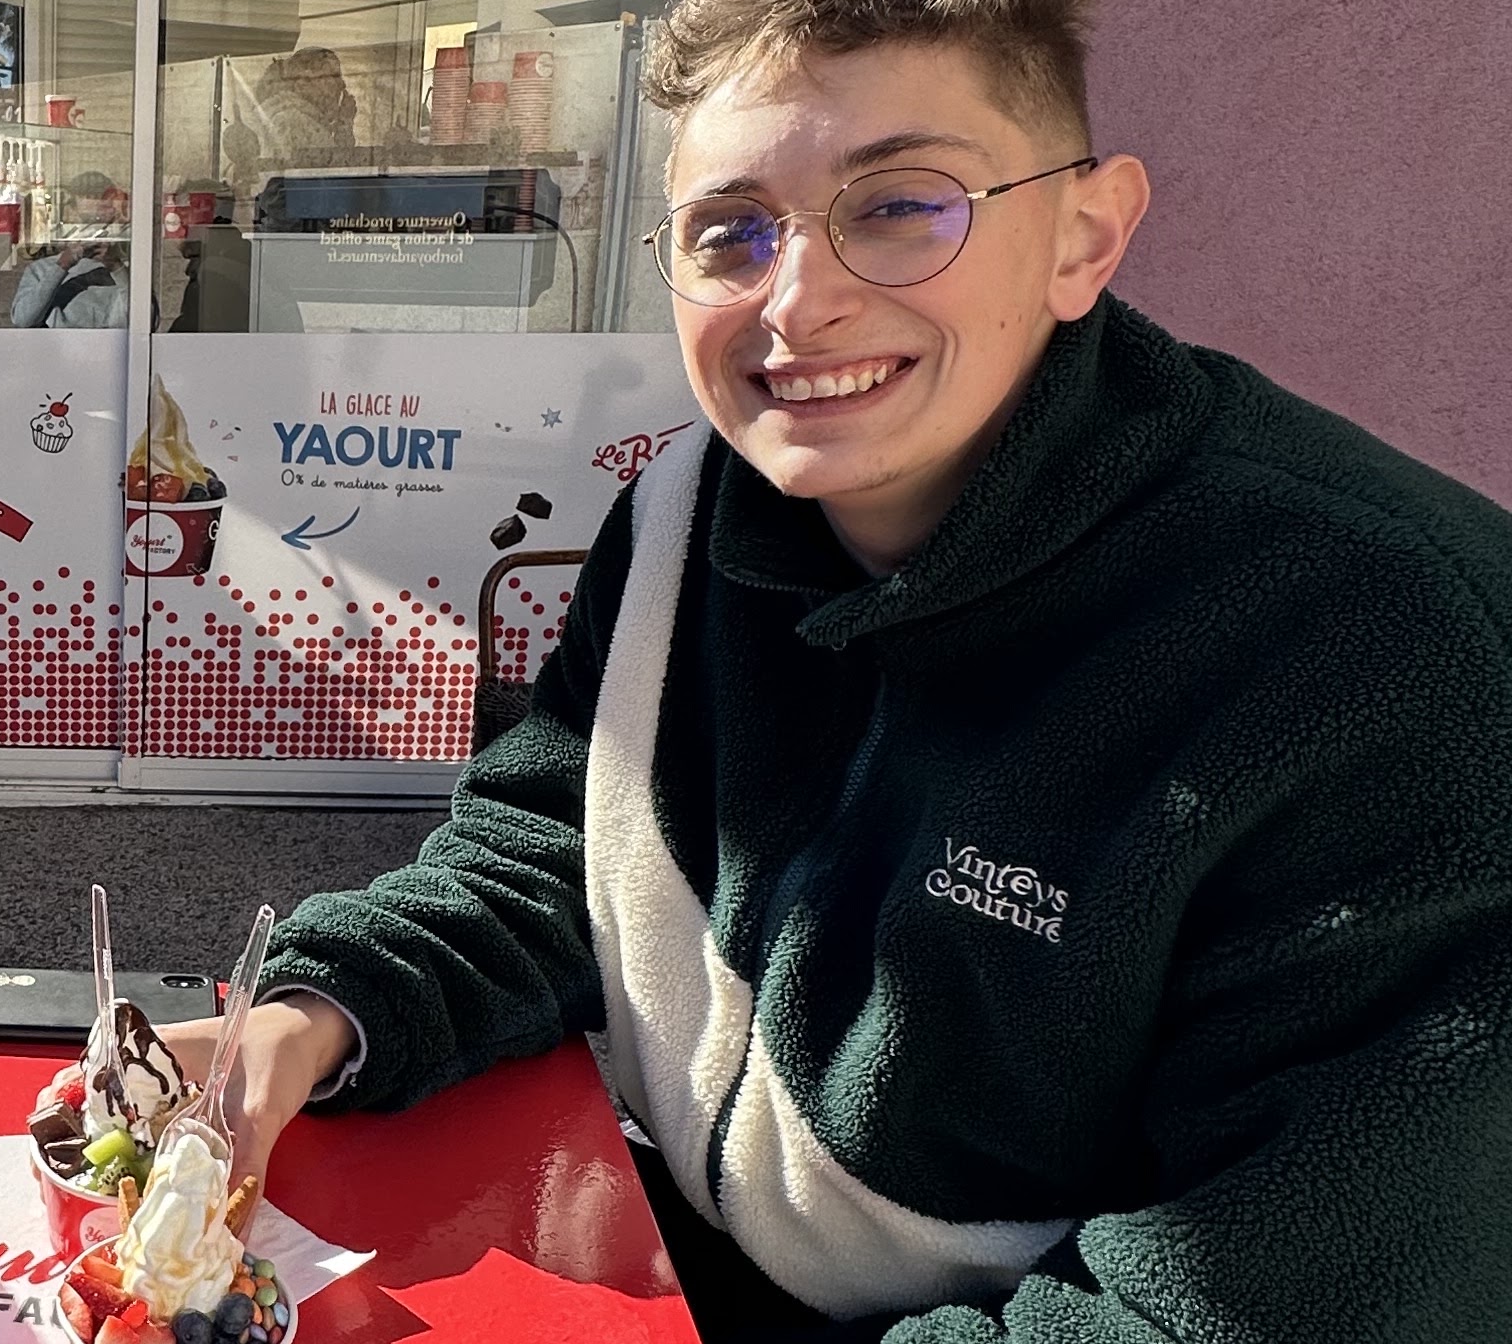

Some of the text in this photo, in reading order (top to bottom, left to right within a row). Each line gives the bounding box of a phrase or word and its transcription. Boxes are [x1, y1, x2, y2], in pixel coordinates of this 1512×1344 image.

[320, 391, 420, 418] LA GLACE AU
[272, 421, 462, 471] YAOURT
[591, 443, 627, 472] Le
[281, 468, 444, 498] 0% de matières grasses
